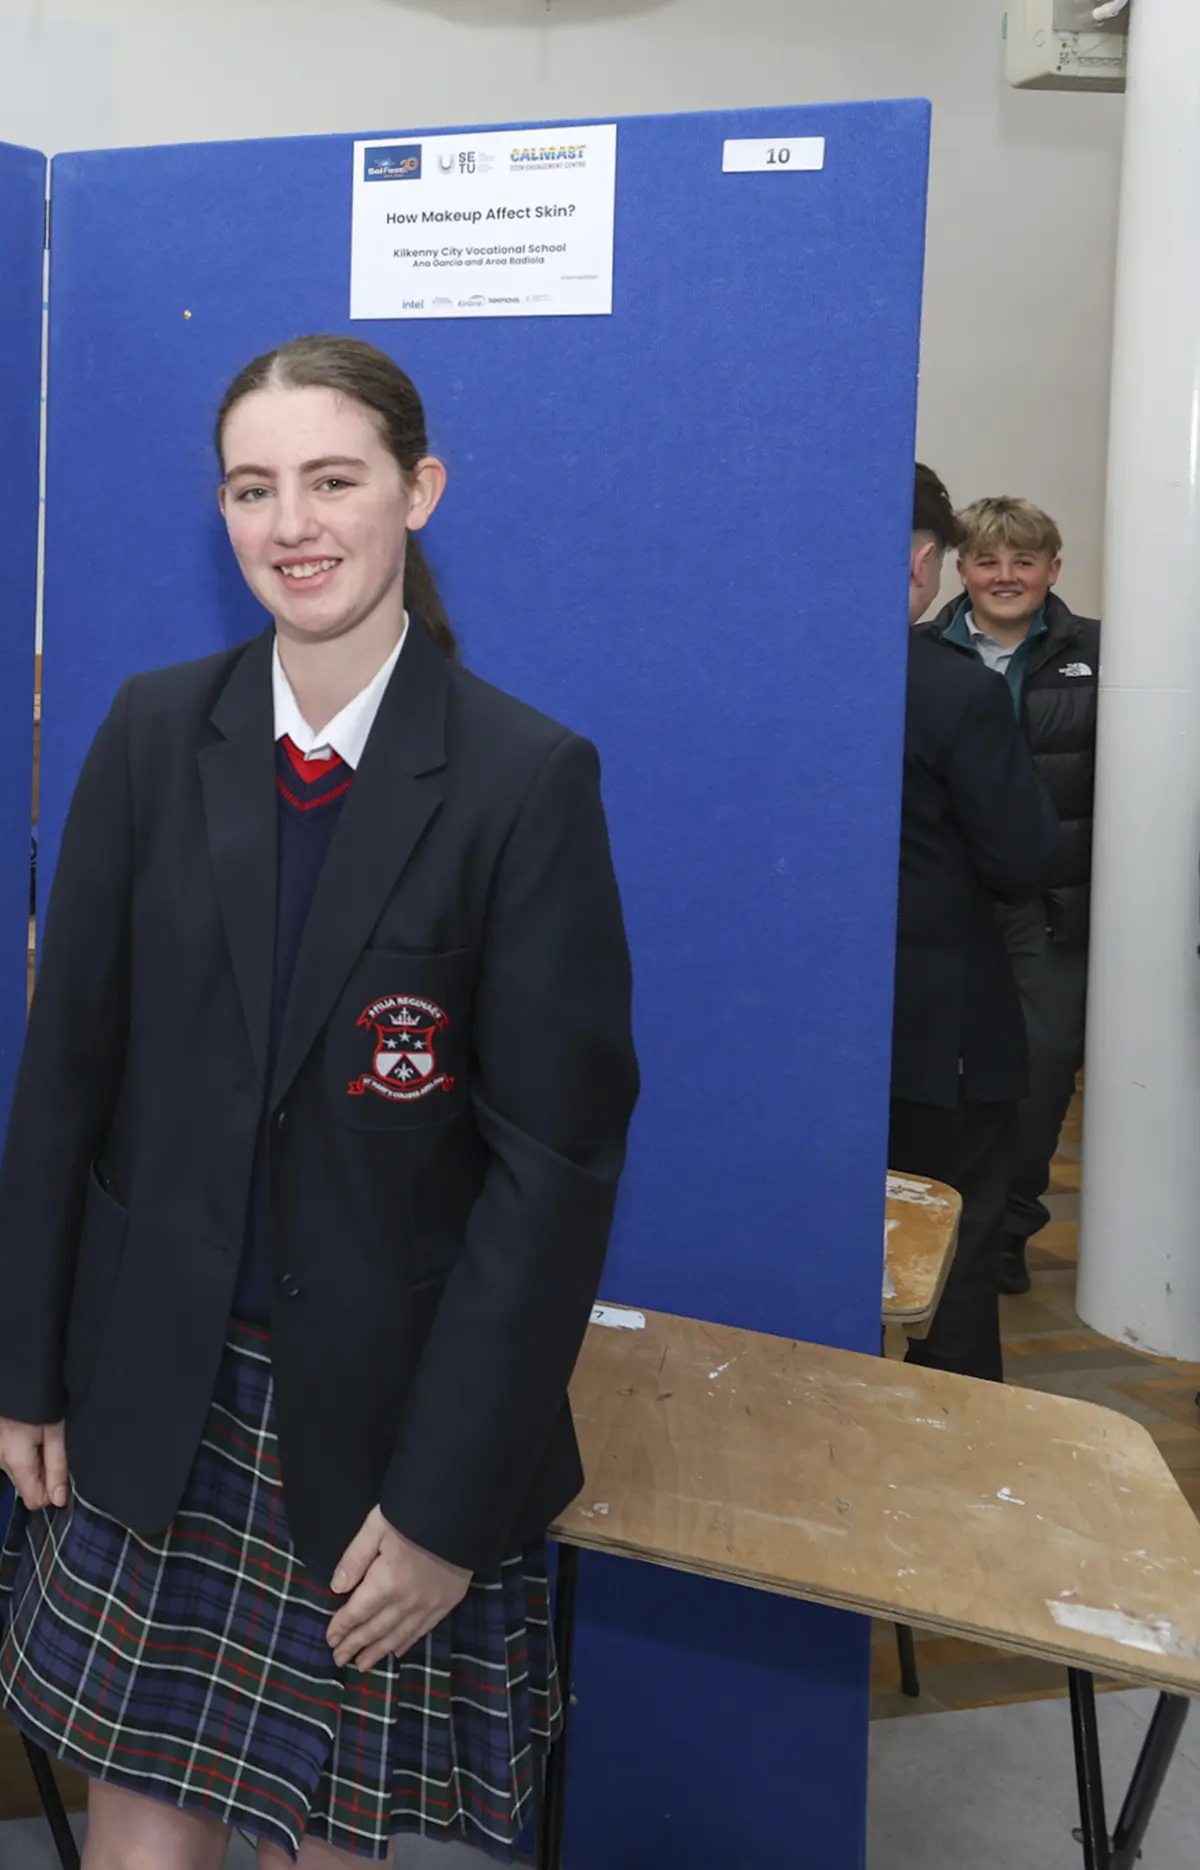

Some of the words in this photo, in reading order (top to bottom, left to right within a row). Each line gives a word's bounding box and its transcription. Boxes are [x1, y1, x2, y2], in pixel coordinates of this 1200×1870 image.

[458, 152, 476, 163] SE
[510, 145, 587, 162] CALMAST
[766, 148, 791, 164] 10
[458, 163, 476, 174] TU
[386, 212, 418, 225] How
[421, 209, 482, 224] Makeup
[486, 207, 531, 220] Affect
[535, 204, 576, 218] Skin?
[393, 247, 438, 259] Kilkenny
[441, 246, 463, 258] City
[466, 244, 526, 256] Vocational
[528, 243, 566, 253] School
[412, 259, 431, 268] Ana
[465, 257, 483, 266] and
[485, 257, 507, 265] Aroa
[509, 255, 545, 265] Badiola
[402, 299, 424, 309] intel
